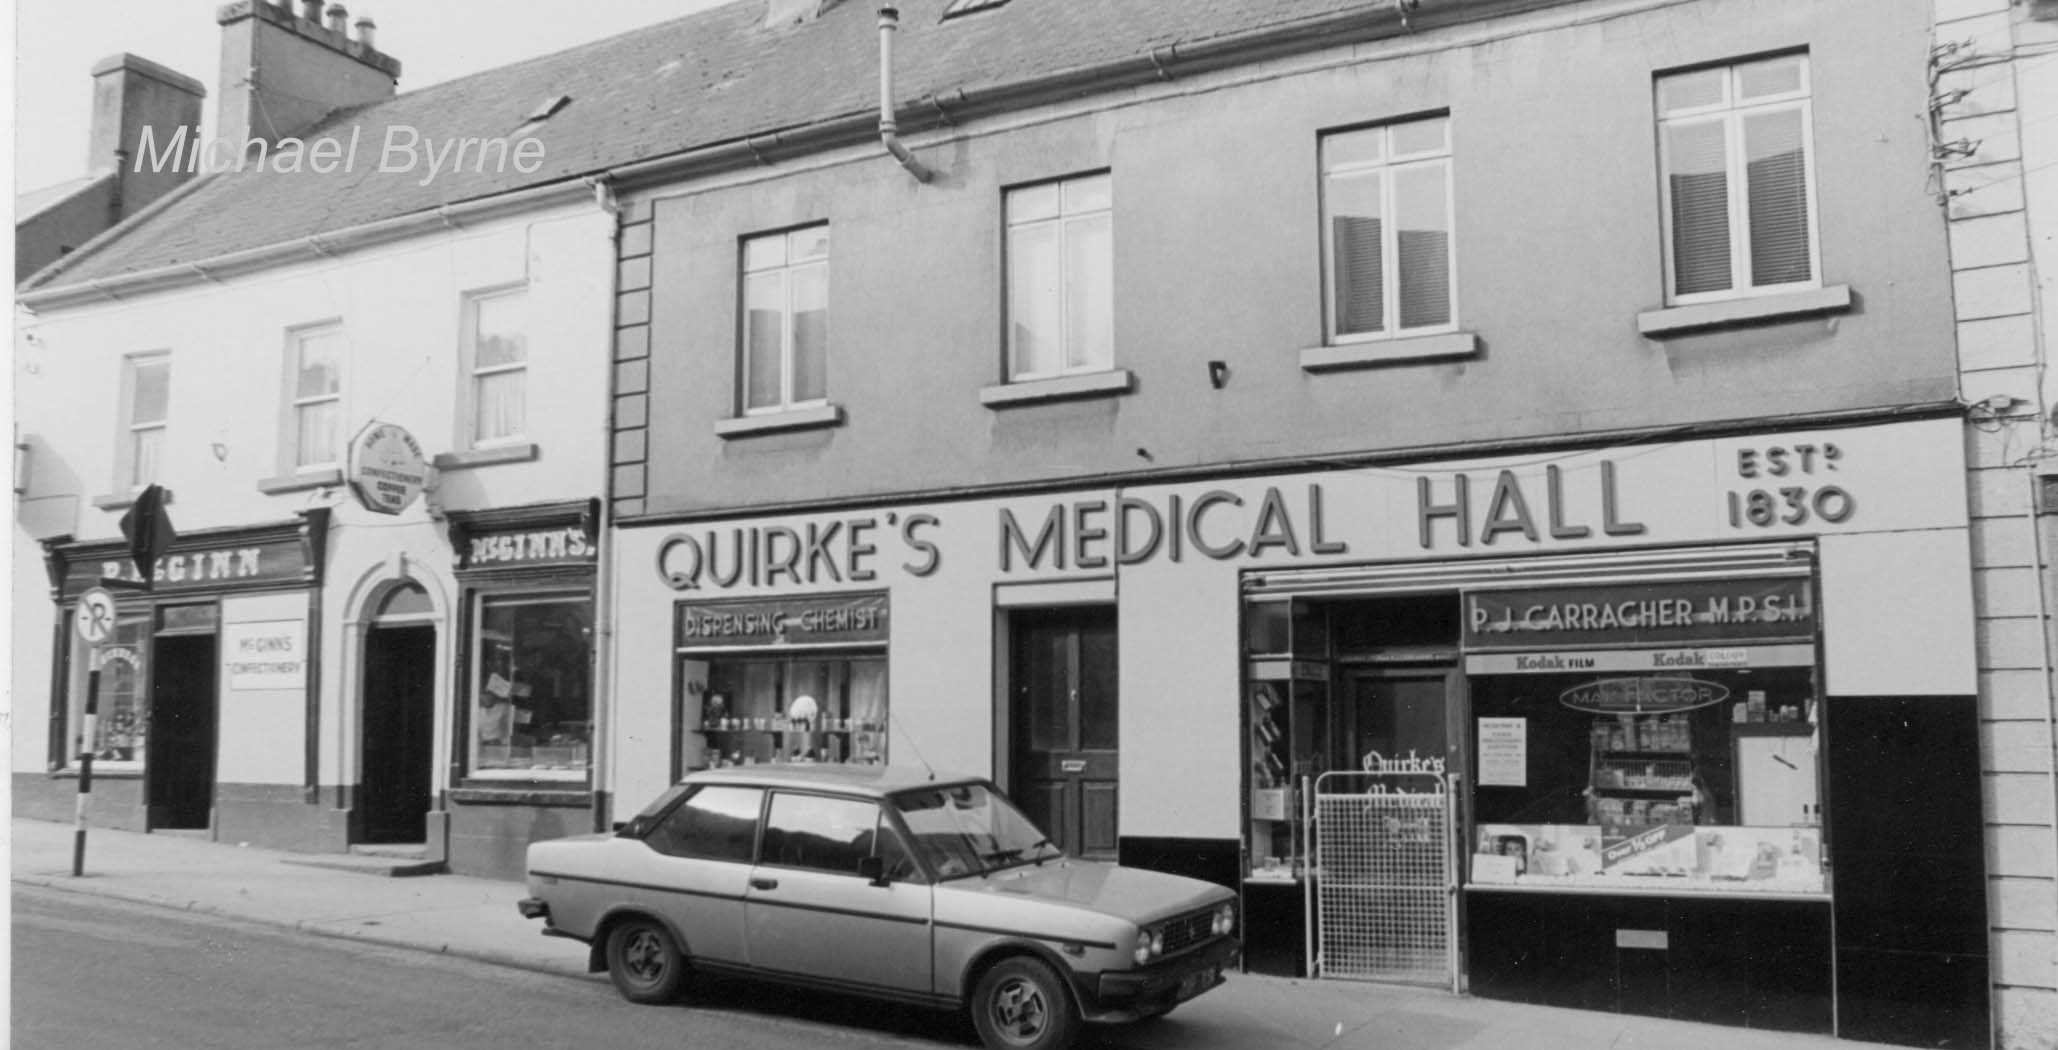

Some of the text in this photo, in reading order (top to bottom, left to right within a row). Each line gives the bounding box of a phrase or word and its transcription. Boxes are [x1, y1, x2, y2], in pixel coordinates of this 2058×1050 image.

[361, 466, 423, 486] CONFECTIONERY
[377, 481, 407, 496] COFFEE
[1727, 485, 1856, 528] 1830
[656, 461, 1645, 590] QUIRKE'S MEDICAL HALL
[685, 607, 879, 637] DISPENSING CHEMIST
[1525, 599, 1692, 630] CARRAGHER
[231, 661, 301, 675] CONFECTIONERY
[1516, 655, 1595, 669] Kodak FILM
[1652, 651, 1704, 667] Kodak
[1363, 749, 1445, 777] Quirke's
